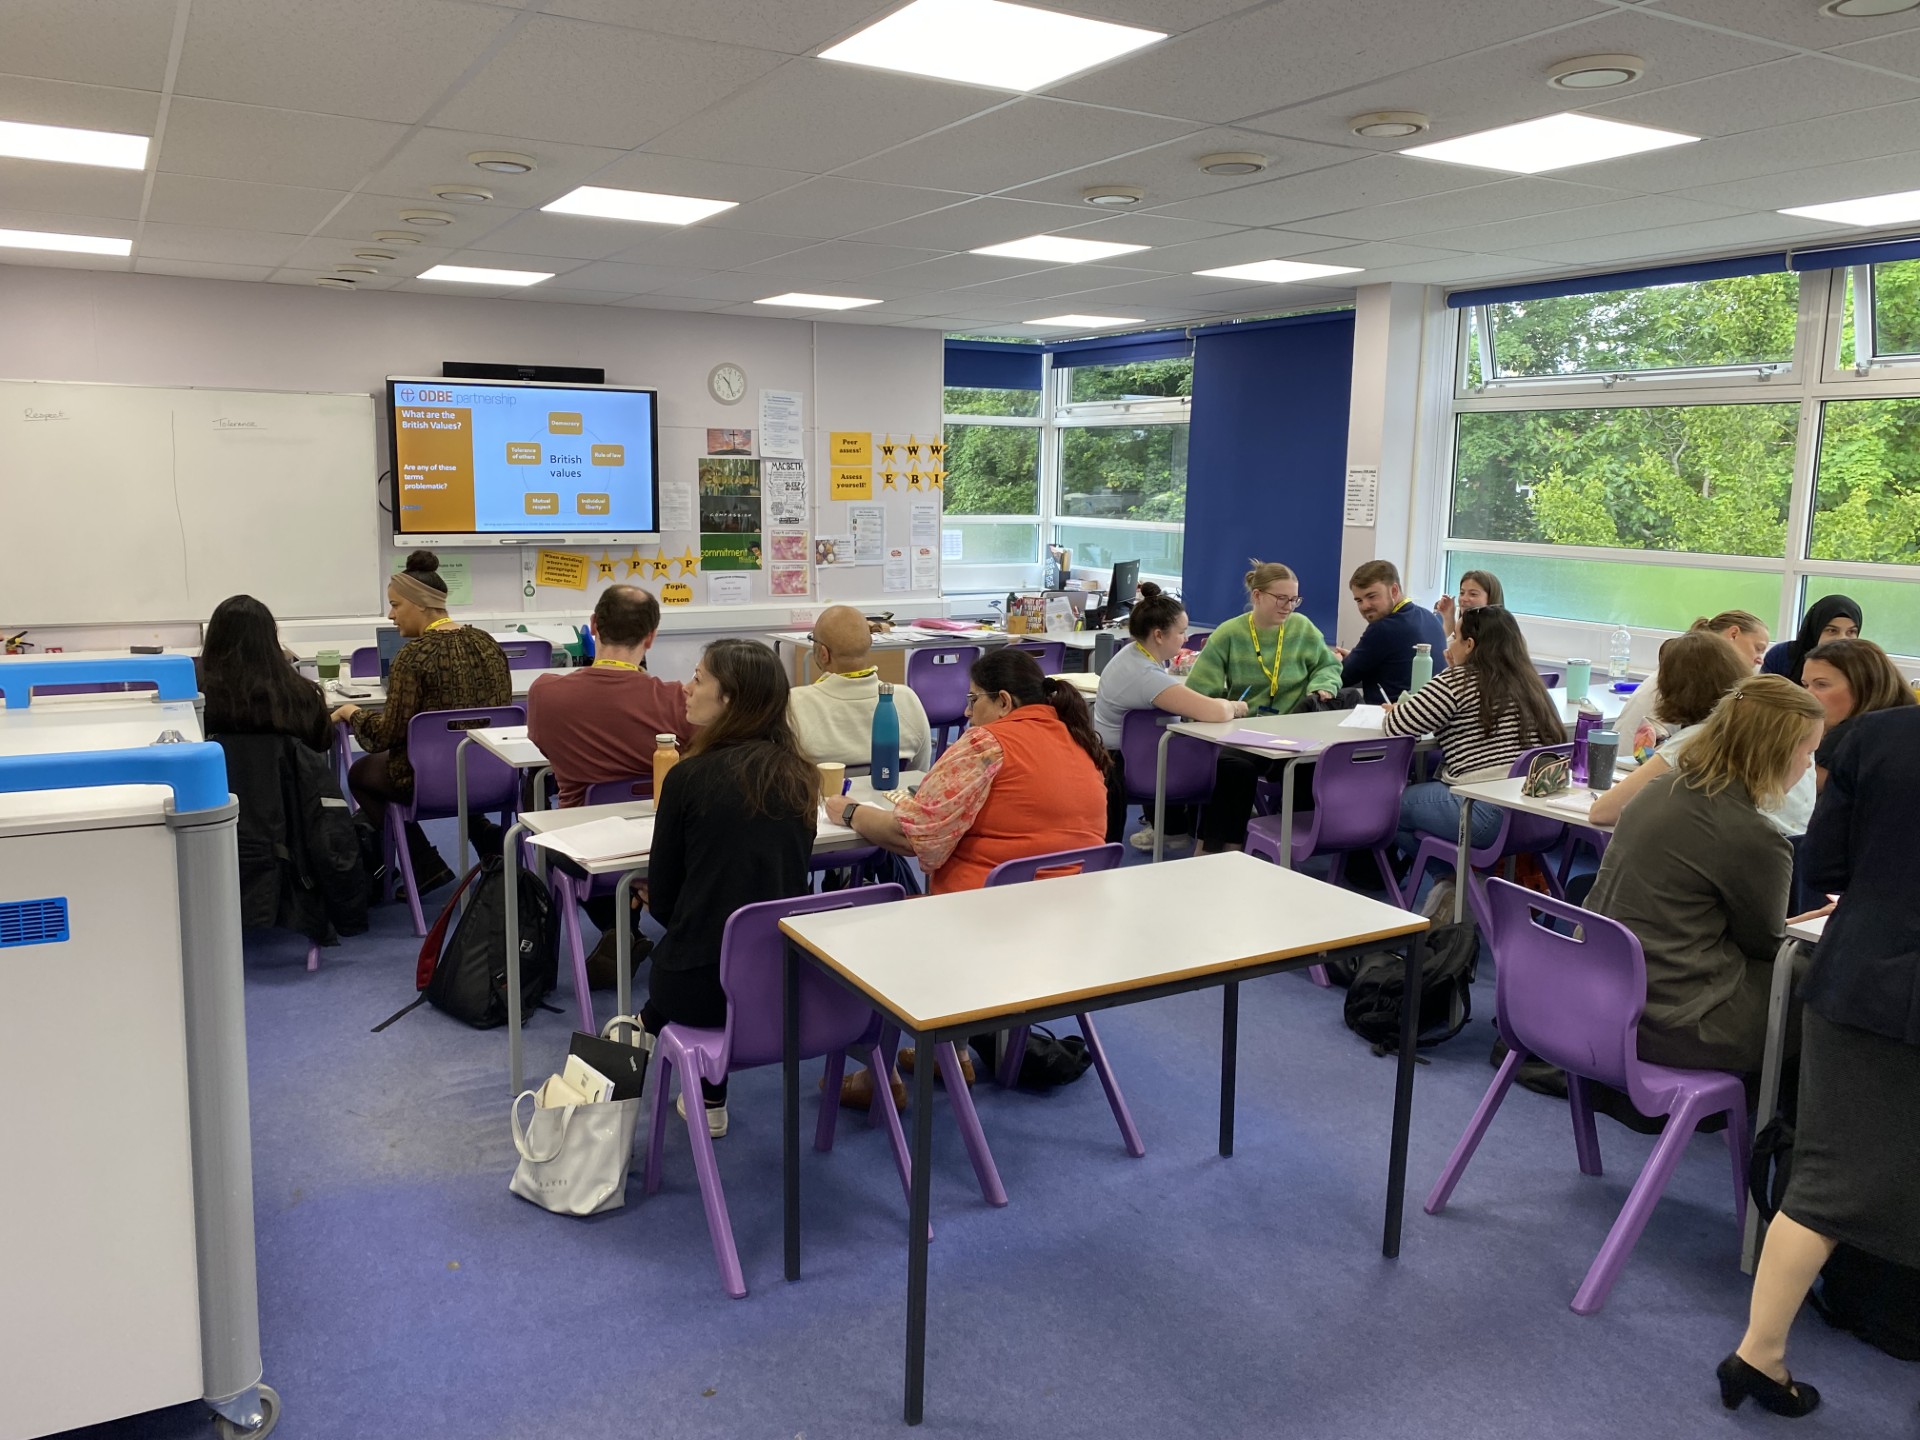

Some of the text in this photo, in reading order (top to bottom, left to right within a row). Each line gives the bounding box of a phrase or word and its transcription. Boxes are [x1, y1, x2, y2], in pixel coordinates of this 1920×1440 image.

[418, 390, 516, 408] ODBE partnership
[24, 408, 65, 422] Respect
[402, 410, 424, 418] What
[441, 411, 456, 419] the
[212, 418, 258, 428] Tolerance
[402, 420, 462, 430] British Values?
[882, 445, 942, 456] W W W
[550, 454, 582, 464] British
[771, 462, 804, 470] MACBETH
[550, 468, 582, 478] values
[885, 474, 939, 484] E B I
[700, 548, 748, 558] commitment
[600, 564, 612, 572] Ti
[632, 561, 640, 570] P
[685, 560, 692, 568] P
